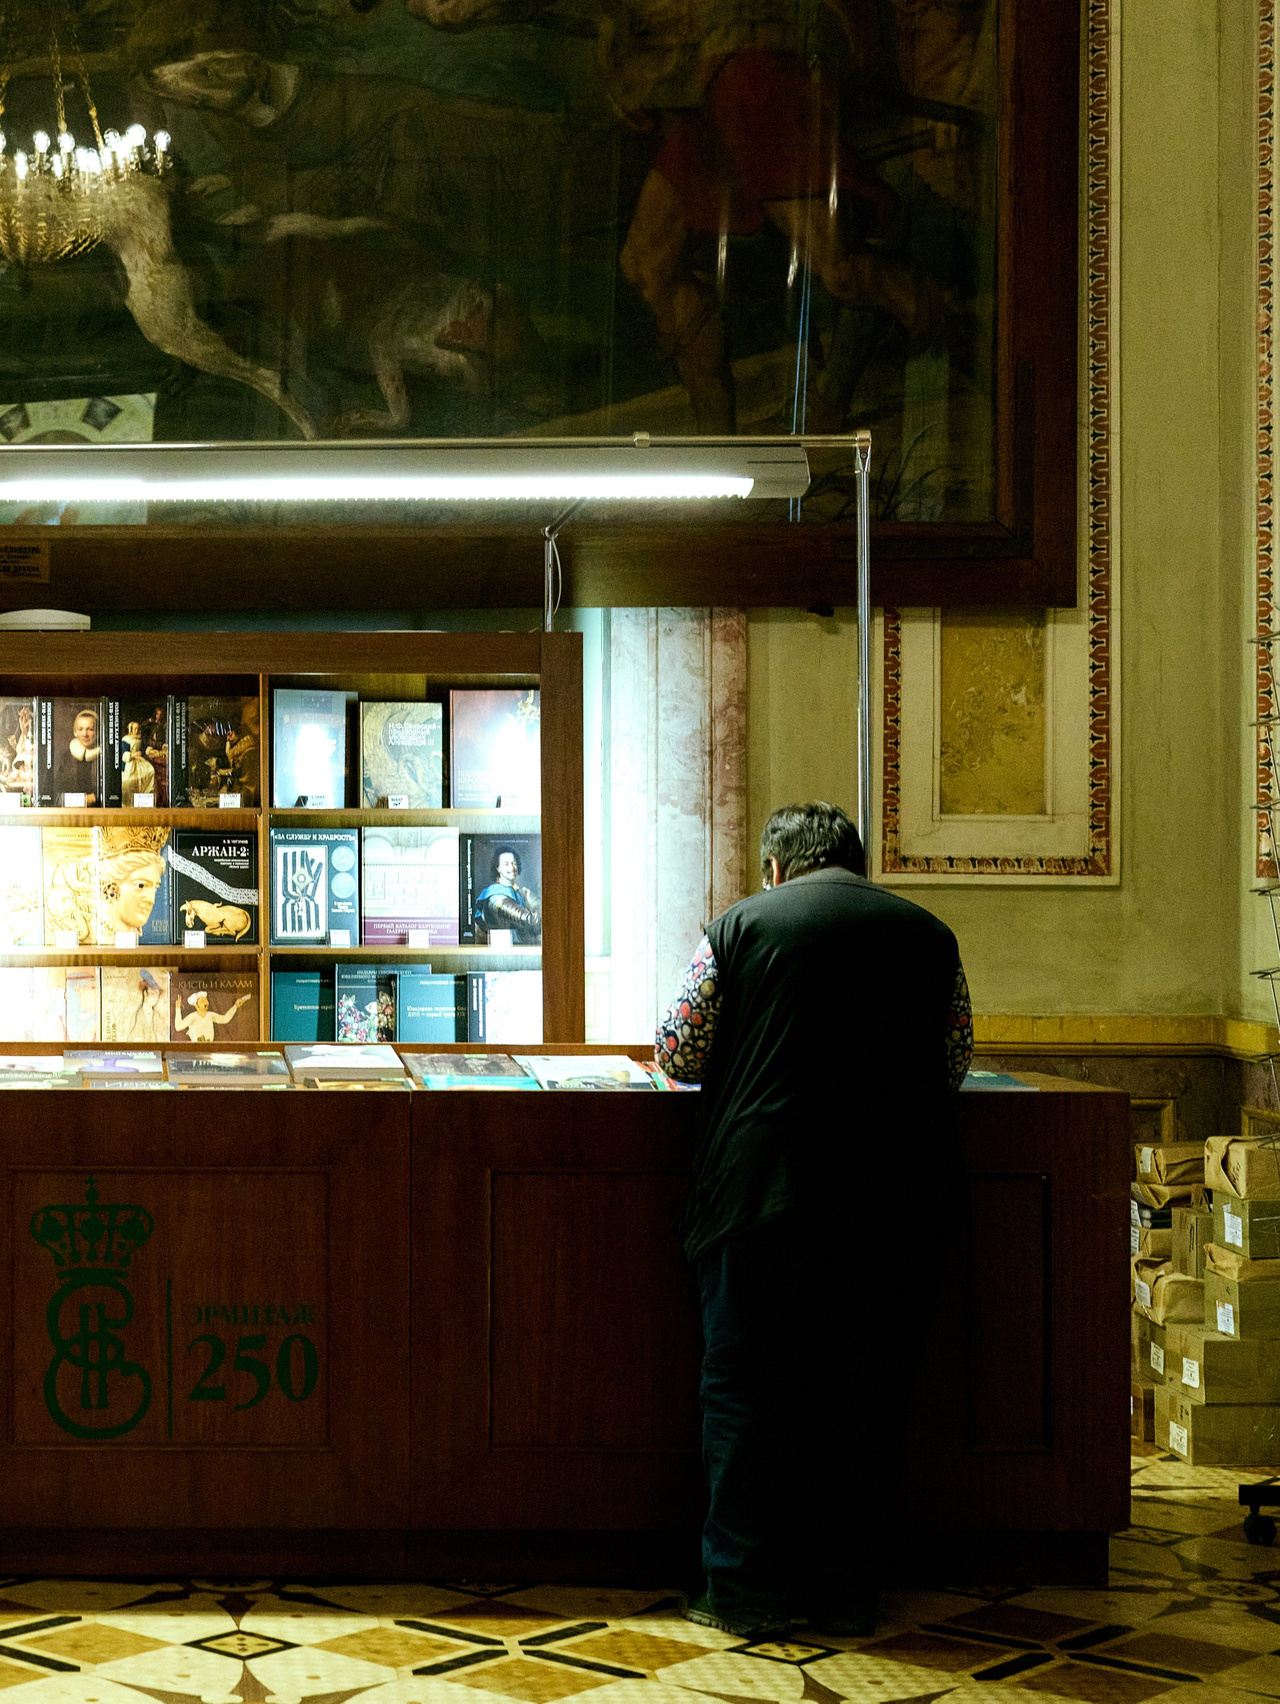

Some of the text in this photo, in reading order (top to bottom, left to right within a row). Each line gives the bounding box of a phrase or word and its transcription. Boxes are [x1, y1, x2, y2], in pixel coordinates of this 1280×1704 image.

[191, 845, 250, 857] АРЖАН-2:
[178, 980, 253, 989] КИСТЬ И КАЛАМ
[190, 1304, 318, 1326] ЭРМИТАЖ
[186, 1332, 320, 1412] 250
